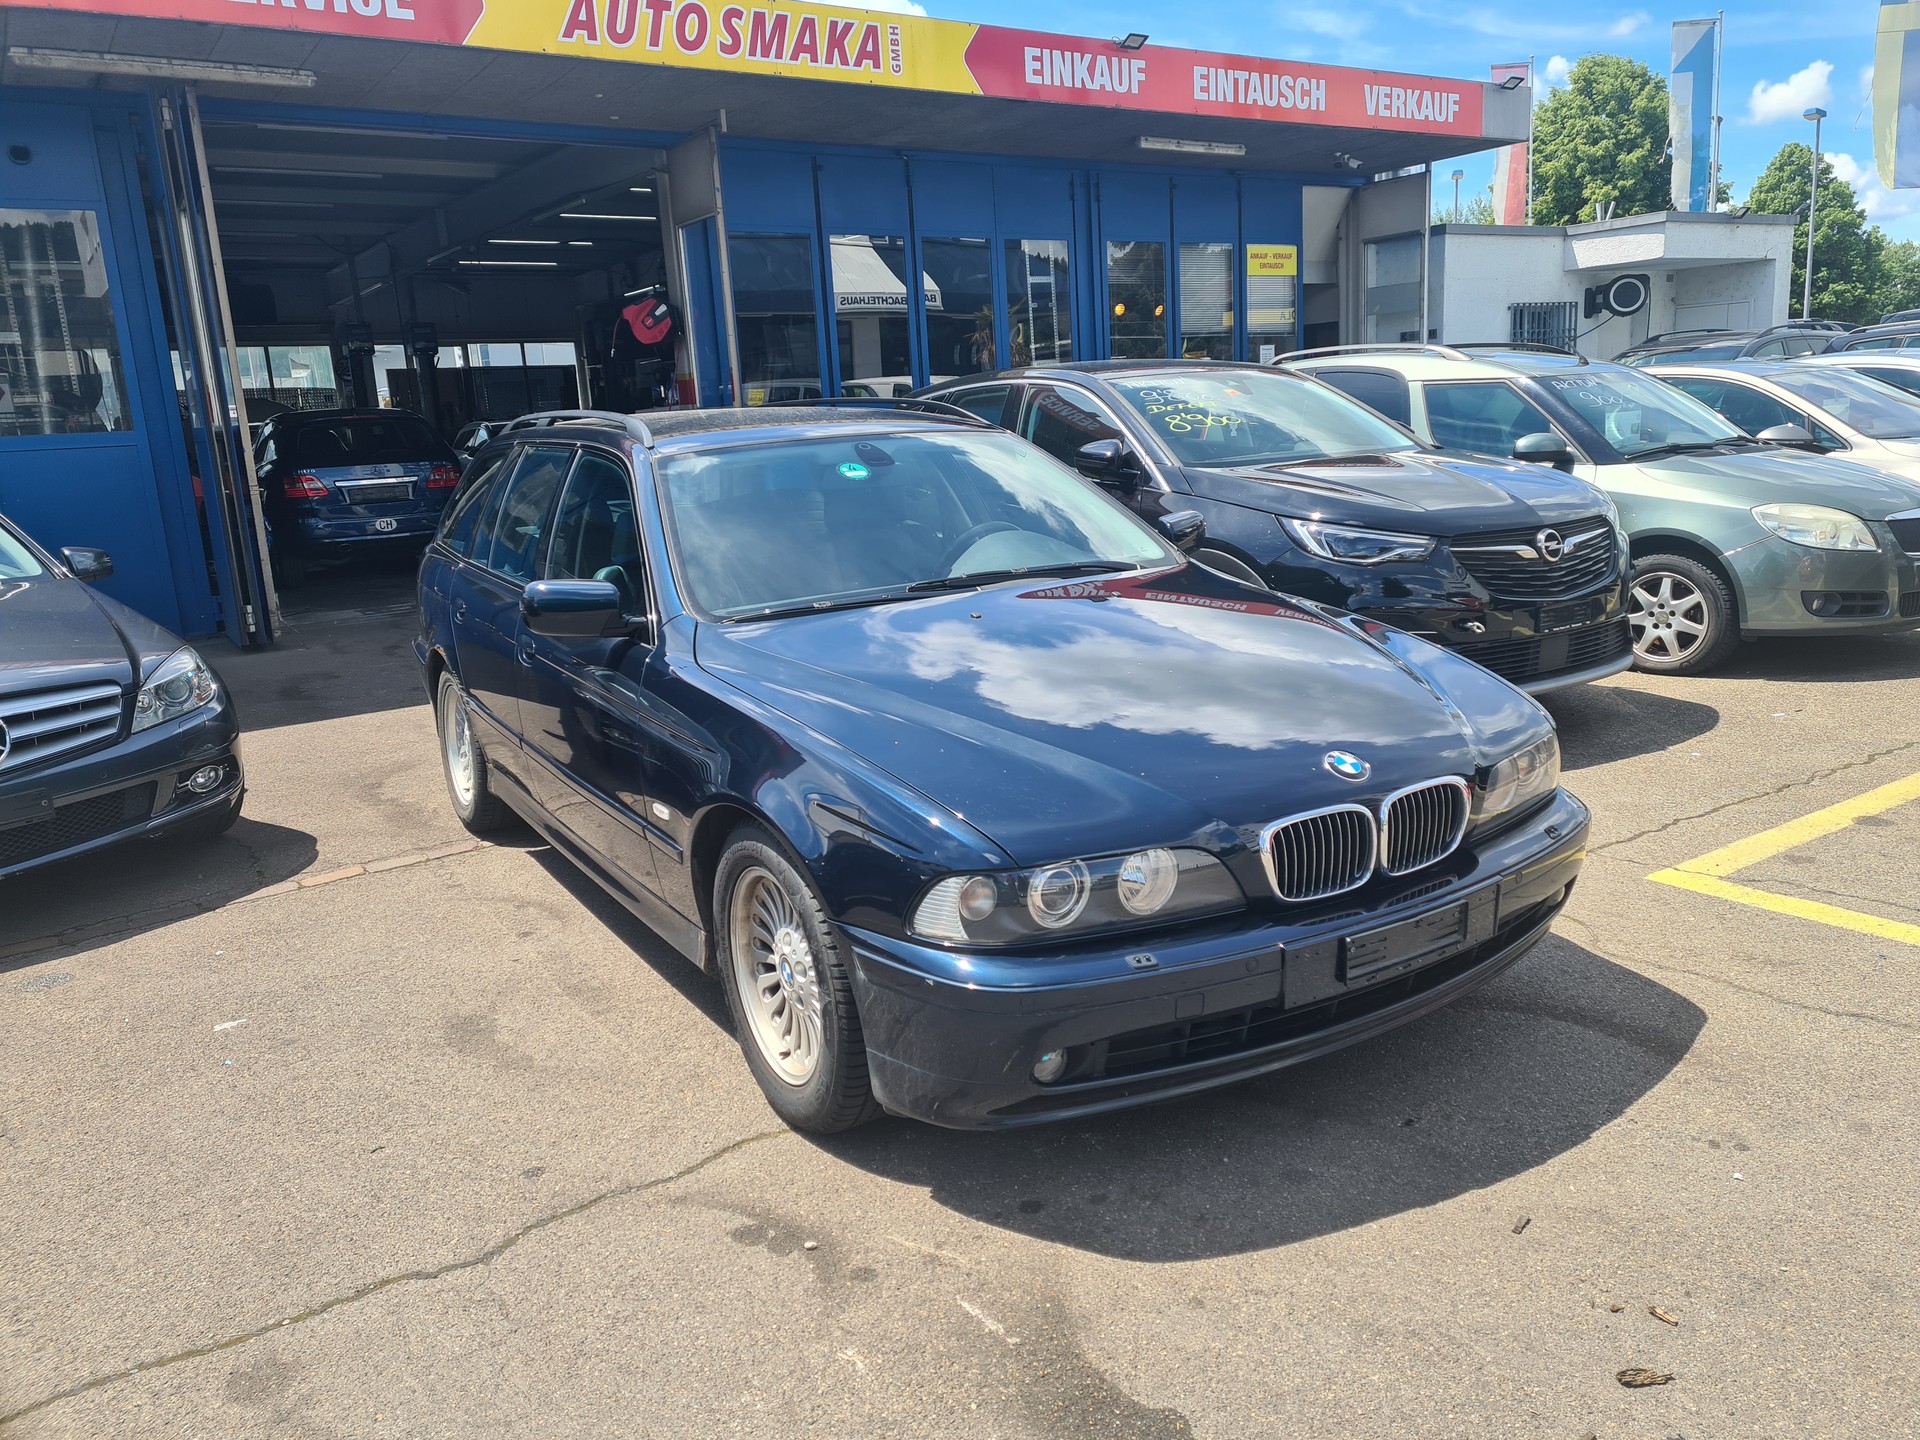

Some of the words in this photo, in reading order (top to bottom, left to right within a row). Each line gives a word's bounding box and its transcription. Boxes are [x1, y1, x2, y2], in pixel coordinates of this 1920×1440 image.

[560, 0, 711, 54] AUTO
[718, 5, 883, 72] SMAKA
[887, 24, 902, 74] GMBH
[1024, 46, 1146, 94] EINKAUF
[1193, 65, 1326, 111] EINTAUSCH
[1364, 83, 1460, 122] VERKAUF
[1250, 252, 1268, 260] ANKAUF
[1272, 252, 1293, 260] VERKAUF
[1259, 262, 1284, 270] EINTAUSCH
[378, 519, 394, 530] CH
